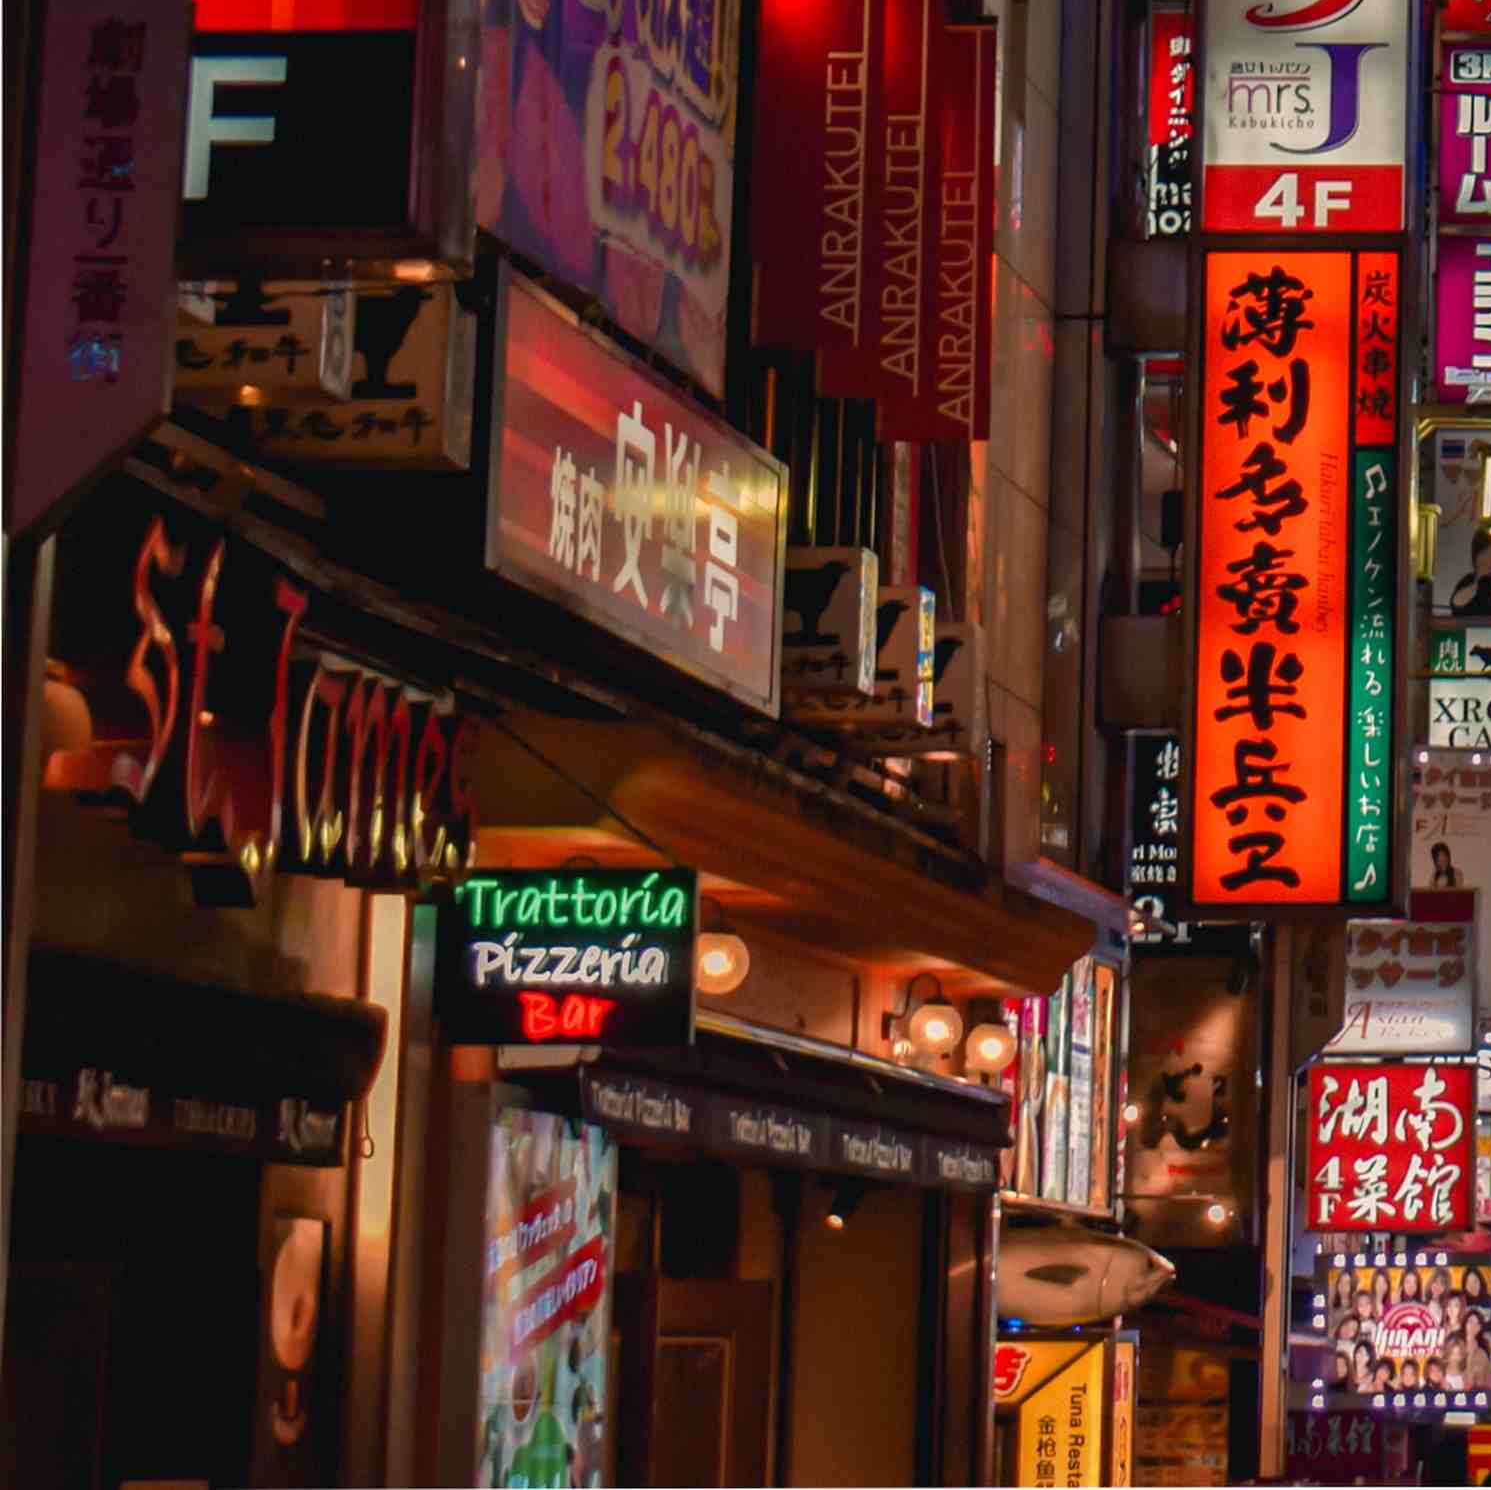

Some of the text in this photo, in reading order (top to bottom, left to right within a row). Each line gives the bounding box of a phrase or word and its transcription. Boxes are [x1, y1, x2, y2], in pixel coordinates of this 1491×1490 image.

[820, 50, 866, 333] ANRAKUTEI
[1253, 171, 1354, 229] 4F
[881, 112, 922, 382] ANRAKUTEI
[937, 169, 977, 427] ANRAKUTEI
[466, 871, 690, 928] Trattoria
[472, 938, 670, 987] Pizzeria
[521, 991, 613, 1041] Bar
[1318, 1066, 1464, 1150] 湖南
[1071, 1383, 1088, 1428] Tuna
